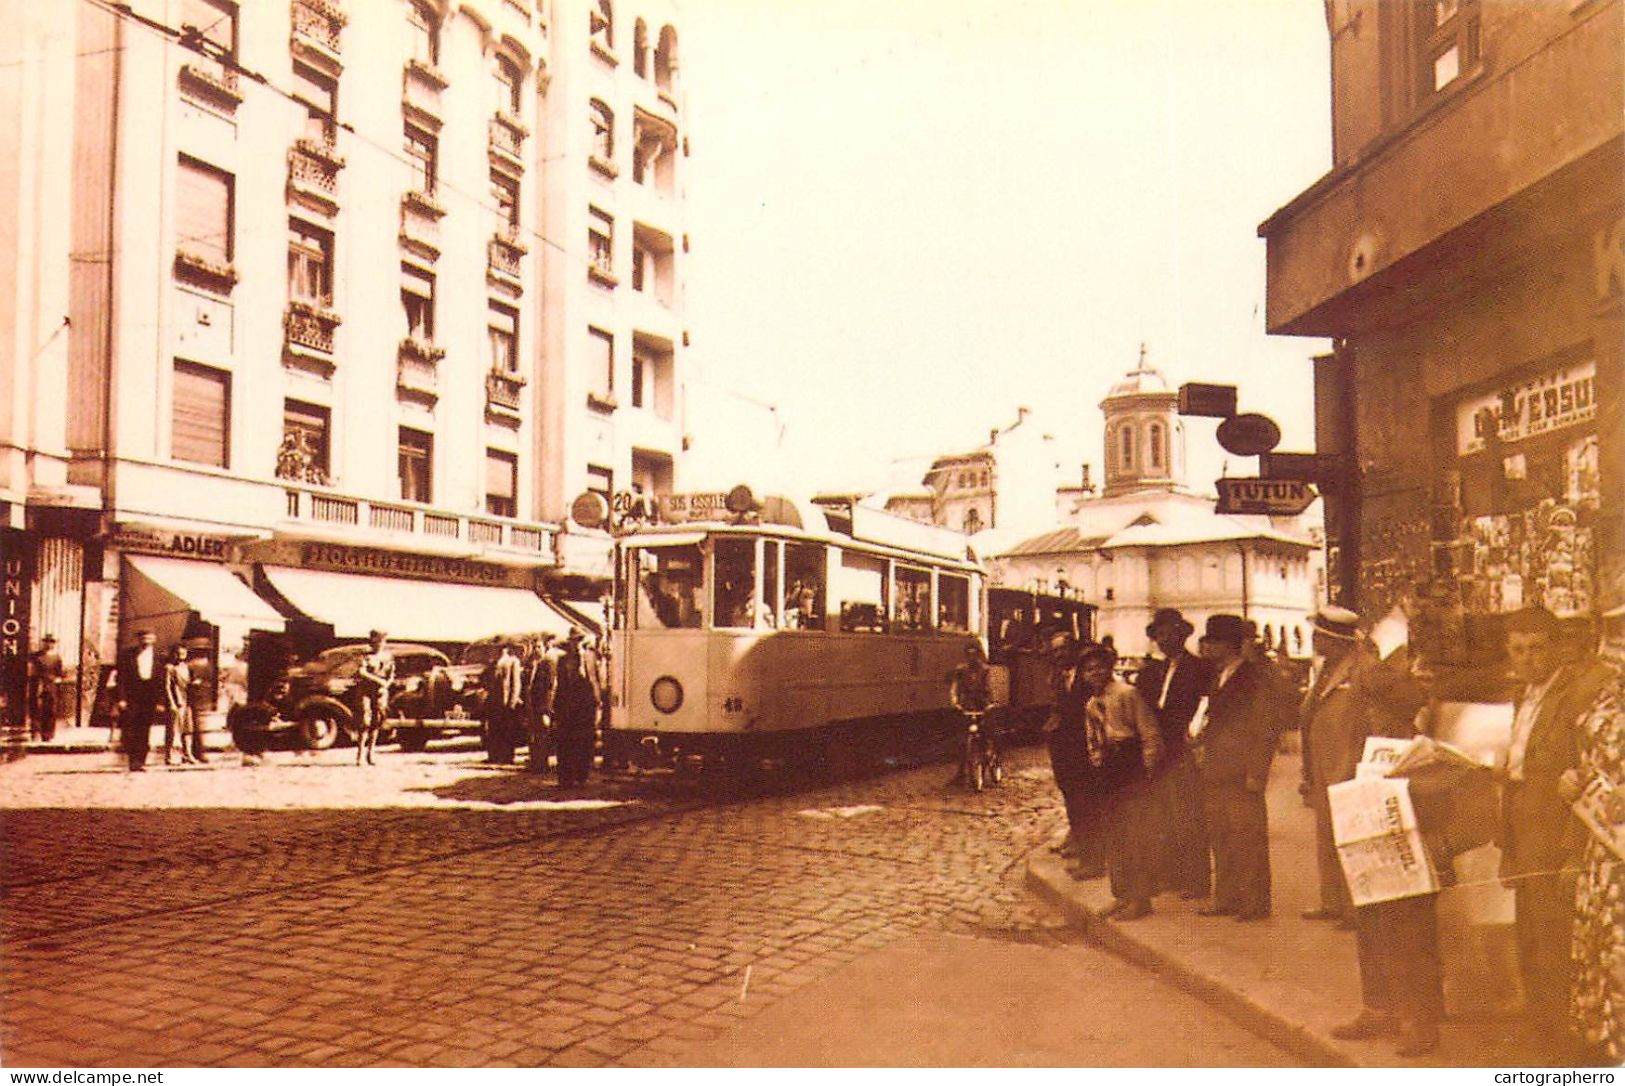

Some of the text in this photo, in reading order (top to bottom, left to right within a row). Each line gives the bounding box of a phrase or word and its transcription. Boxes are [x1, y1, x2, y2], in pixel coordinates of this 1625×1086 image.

[614, 492, 632, 512] 20
[1230, 483, 1305, 500] TUTUN
[172, 534, 224, 557] ADLER
[3, 560, 21, 656] UNION
